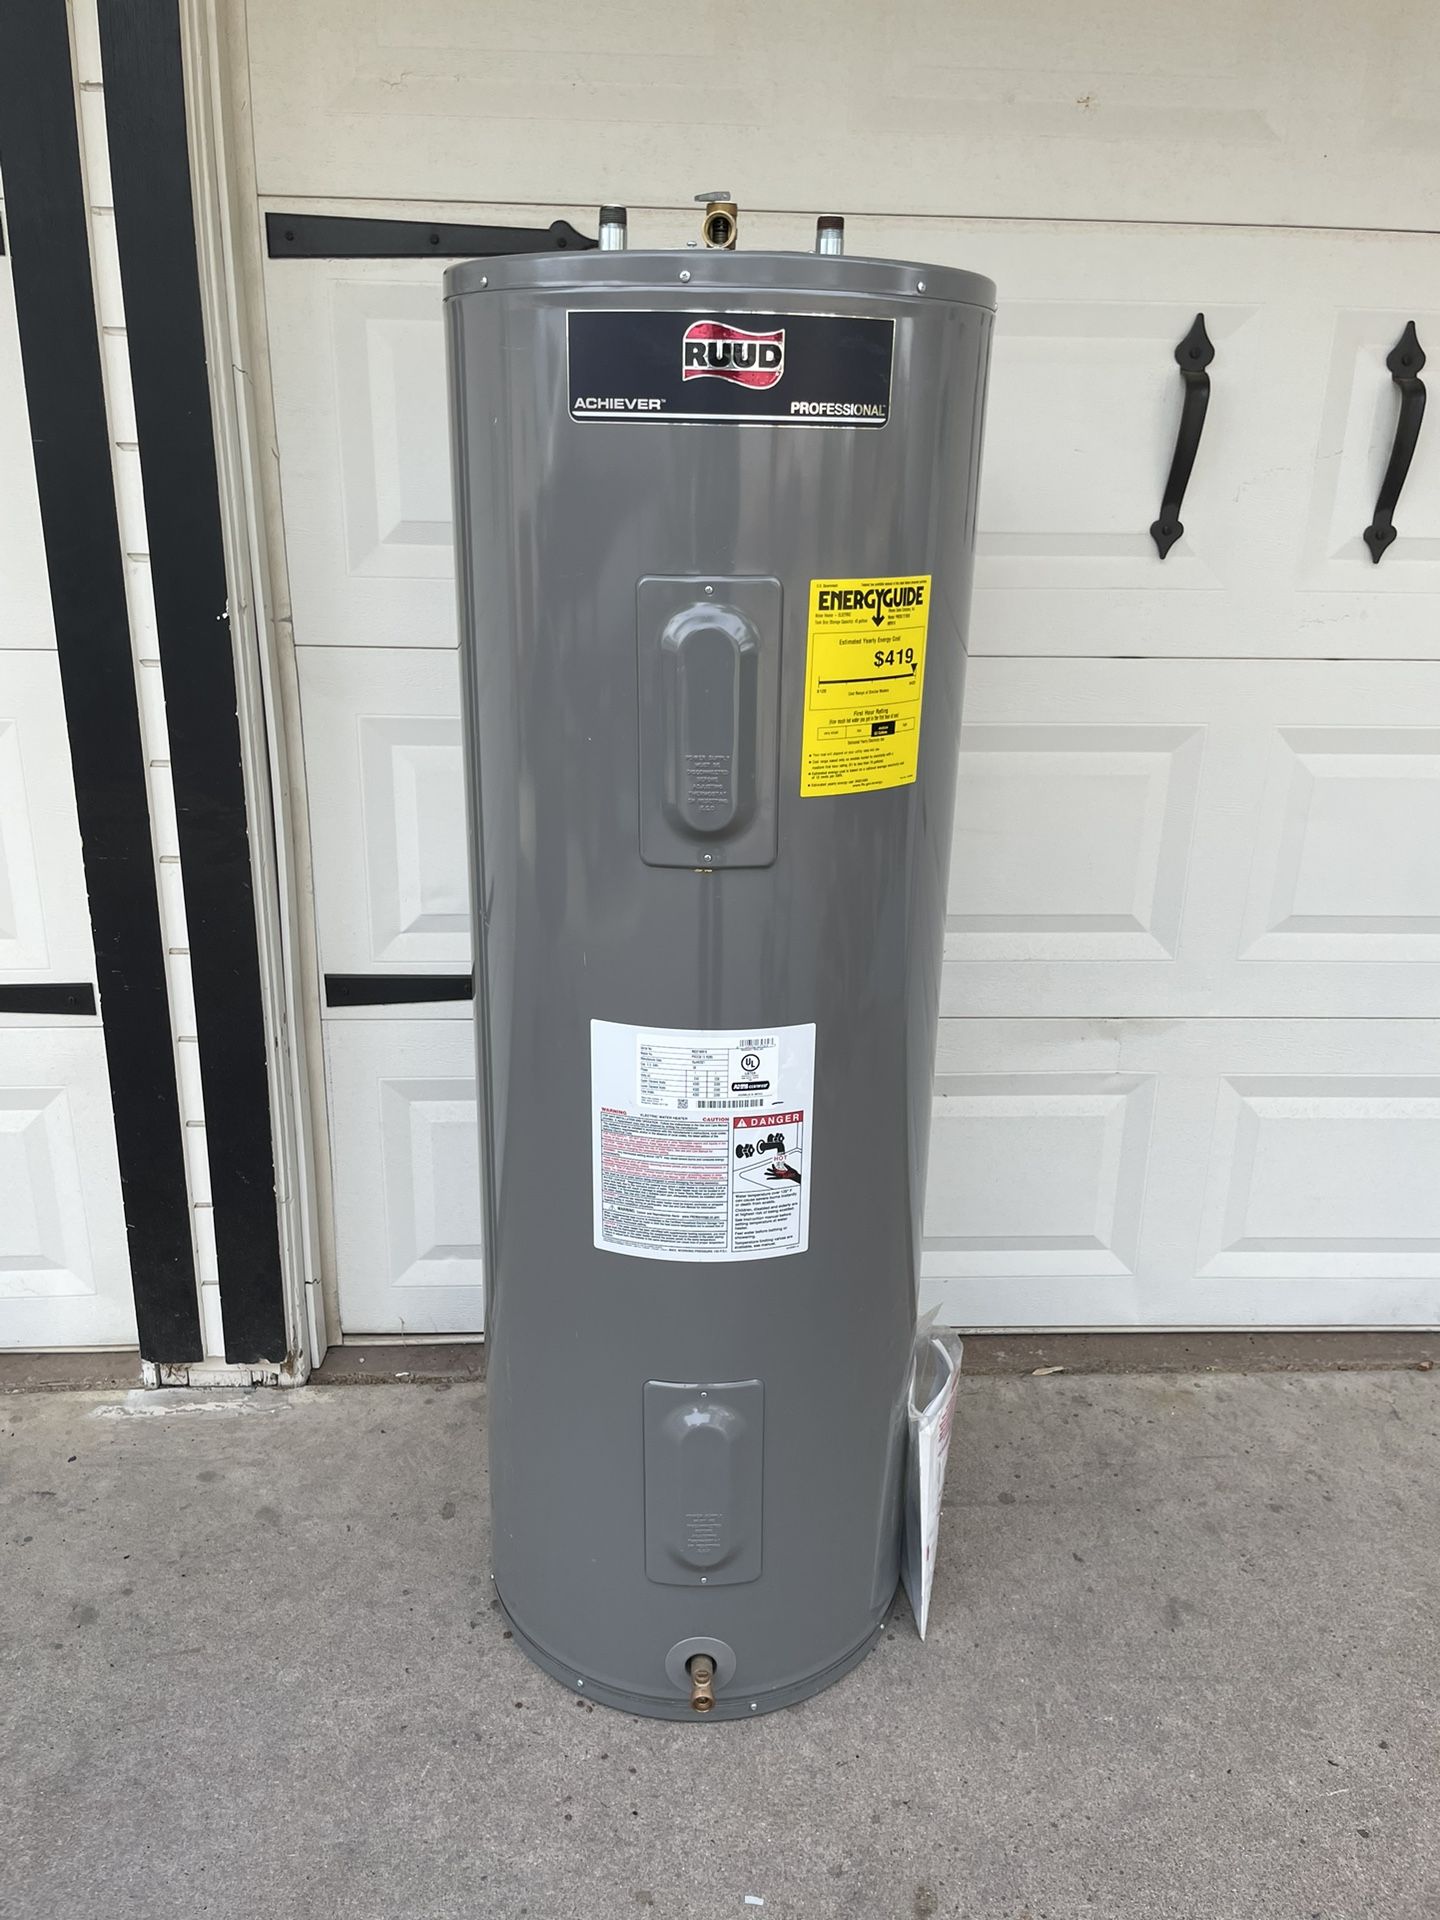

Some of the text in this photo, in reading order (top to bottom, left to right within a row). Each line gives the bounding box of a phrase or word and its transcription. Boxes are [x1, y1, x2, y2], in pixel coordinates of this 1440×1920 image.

[685, 342, 782, 369] RUUD
[574, 398, 661, 410] ACHIEVER
[790, 402, 885, 416] PROFESSIONAL
[818, 586, 924, 611] ENERGYGUIDE
[874, 648, 914, 668] $419
[750, 1113, 799, 1126] DANGER
